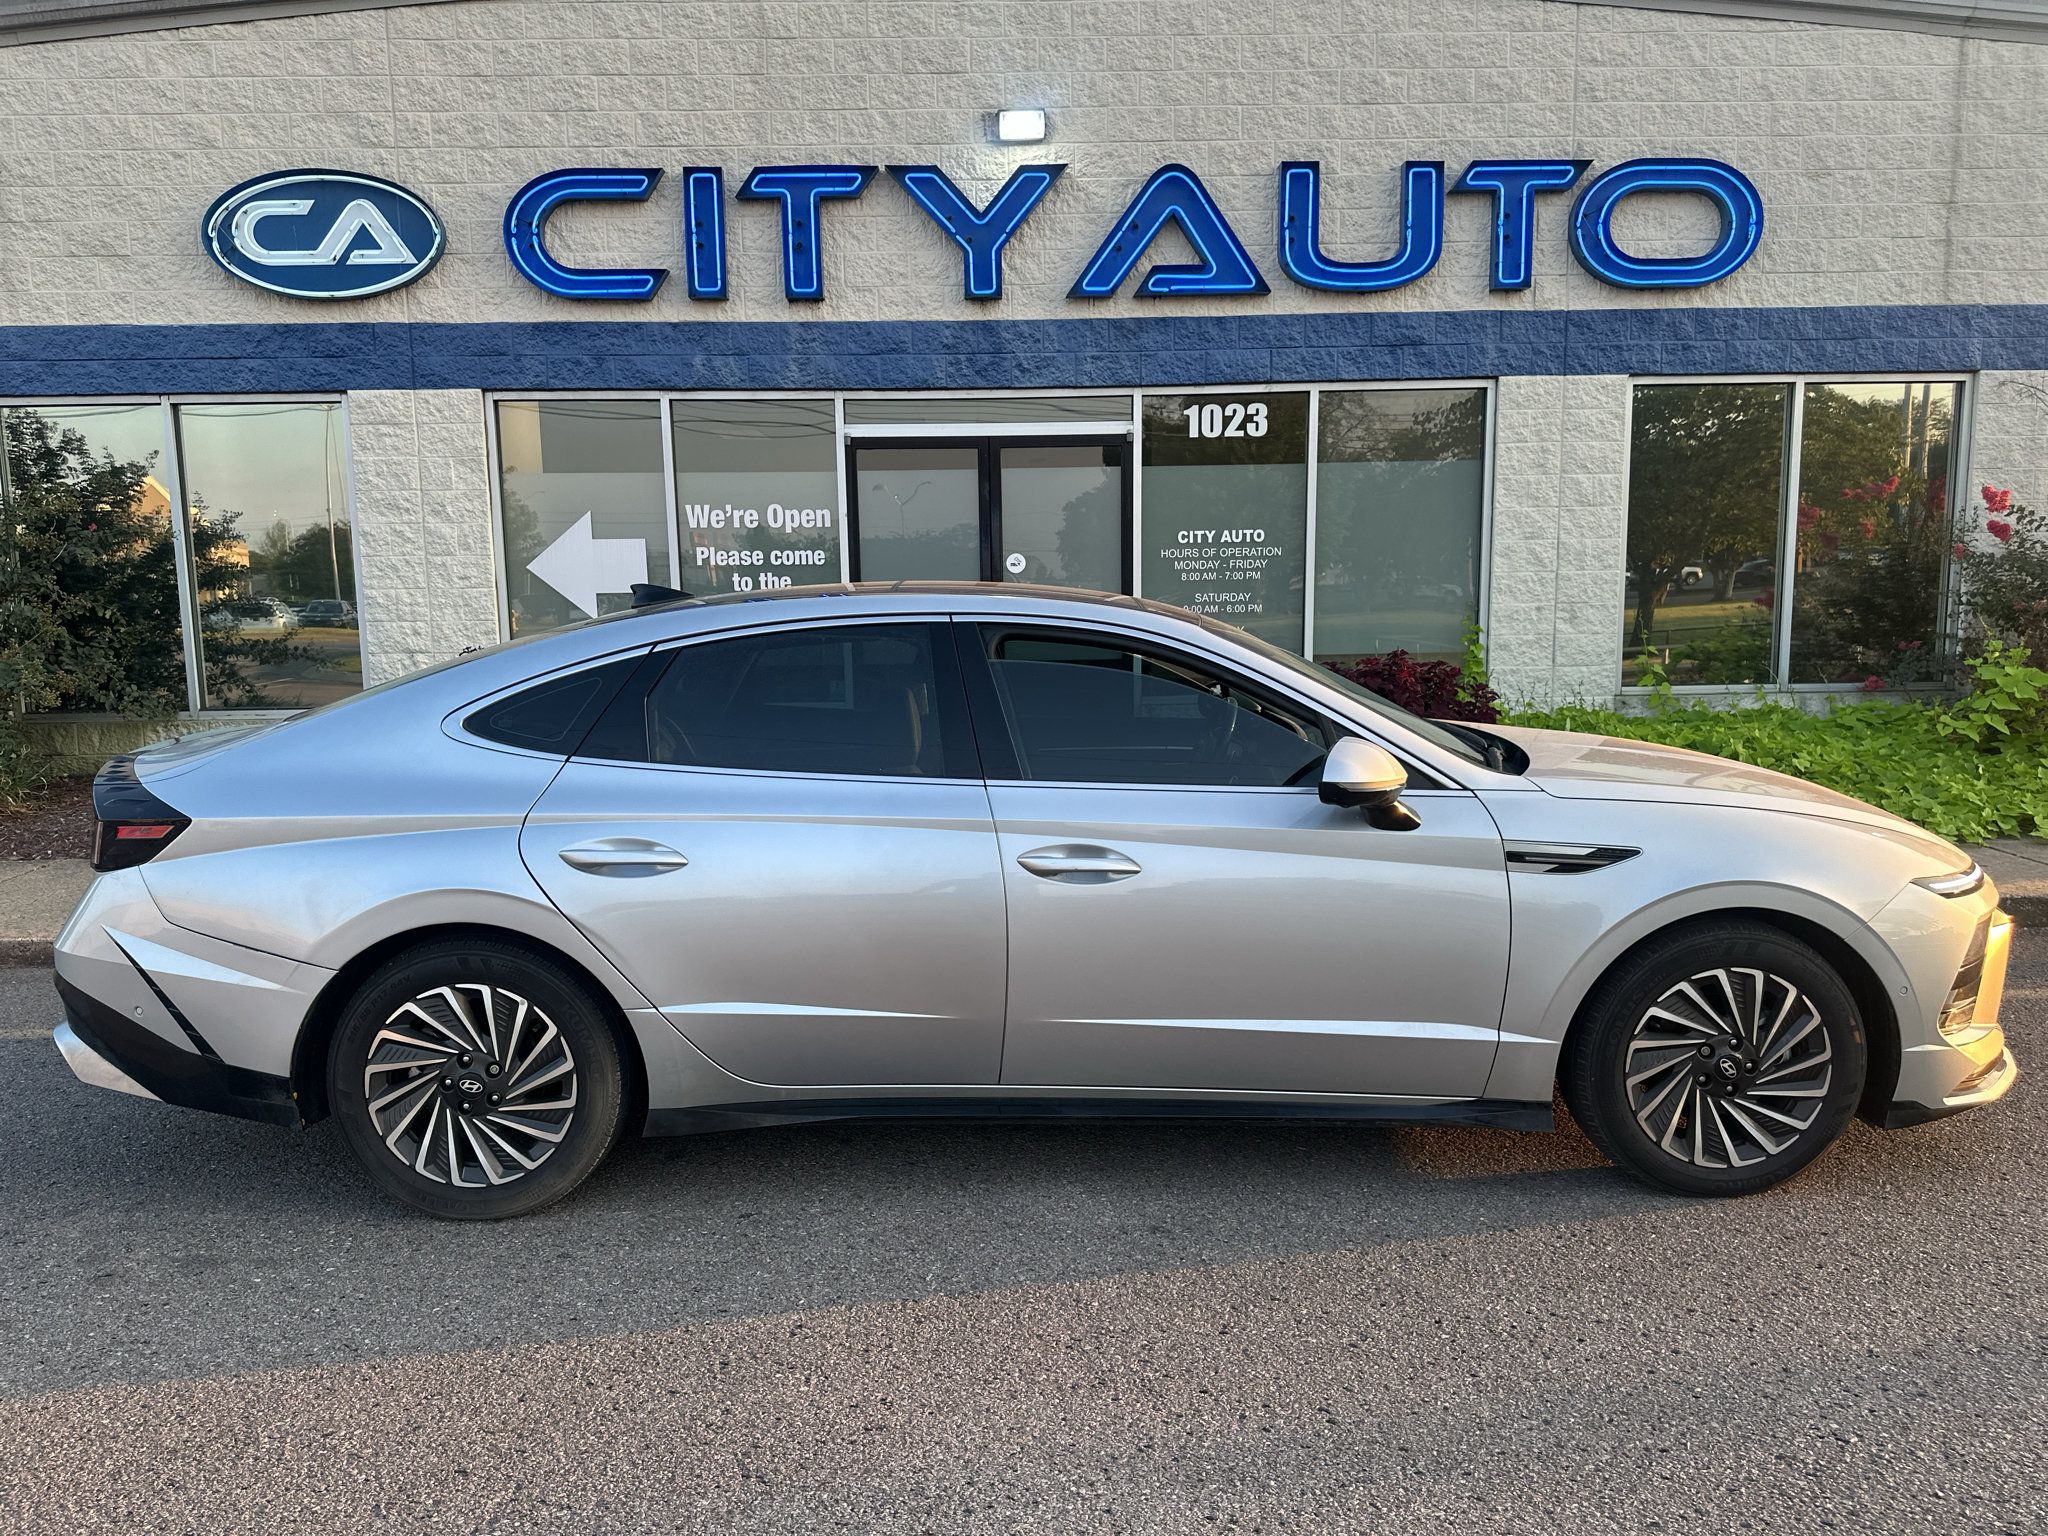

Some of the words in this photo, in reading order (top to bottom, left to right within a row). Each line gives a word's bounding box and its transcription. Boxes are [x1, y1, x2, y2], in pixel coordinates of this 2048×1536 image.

[232, 198, 417, 266] CA
[503, 164, 1067, 302] CITY
[1067, 157, 1765, 299] AUTO
[1184, 403, 1269, 438] 1023
[685, 504, 759, 529] We're
[767, 503, 831, 533] Open
[1177, 530, 1216, 544] CITY
[1220, 529, 1265, 543] AUTO
[696, 546, 764, 566] Please
[770, 549, 826, 566] come
[1160, 548, 1200, 558] HOURS
[1202, 548, 1217, 557] OF
[1220, 547, 1282, 557] OPERATION
[1174, 560, 1220, 570] MONDAY
[1229, 559, 1268, 569] FRIDAY
[732, 573, 753, 592] to
[758, 572, 792, 590] the
[1181, 572, 1200, 581] 8:00
[1202, 572, 1217, 580] AM
[1225, 571, 1244, 580] 7:00
[1246, 571, 1261, 580] PM
[1195, 592, 1251, 602] SATURDAY
[1203, 605, 1218, 613] AM
[1226, 604, 1245, 613] 6:00
[1247, 603, 1263, 613] PM
